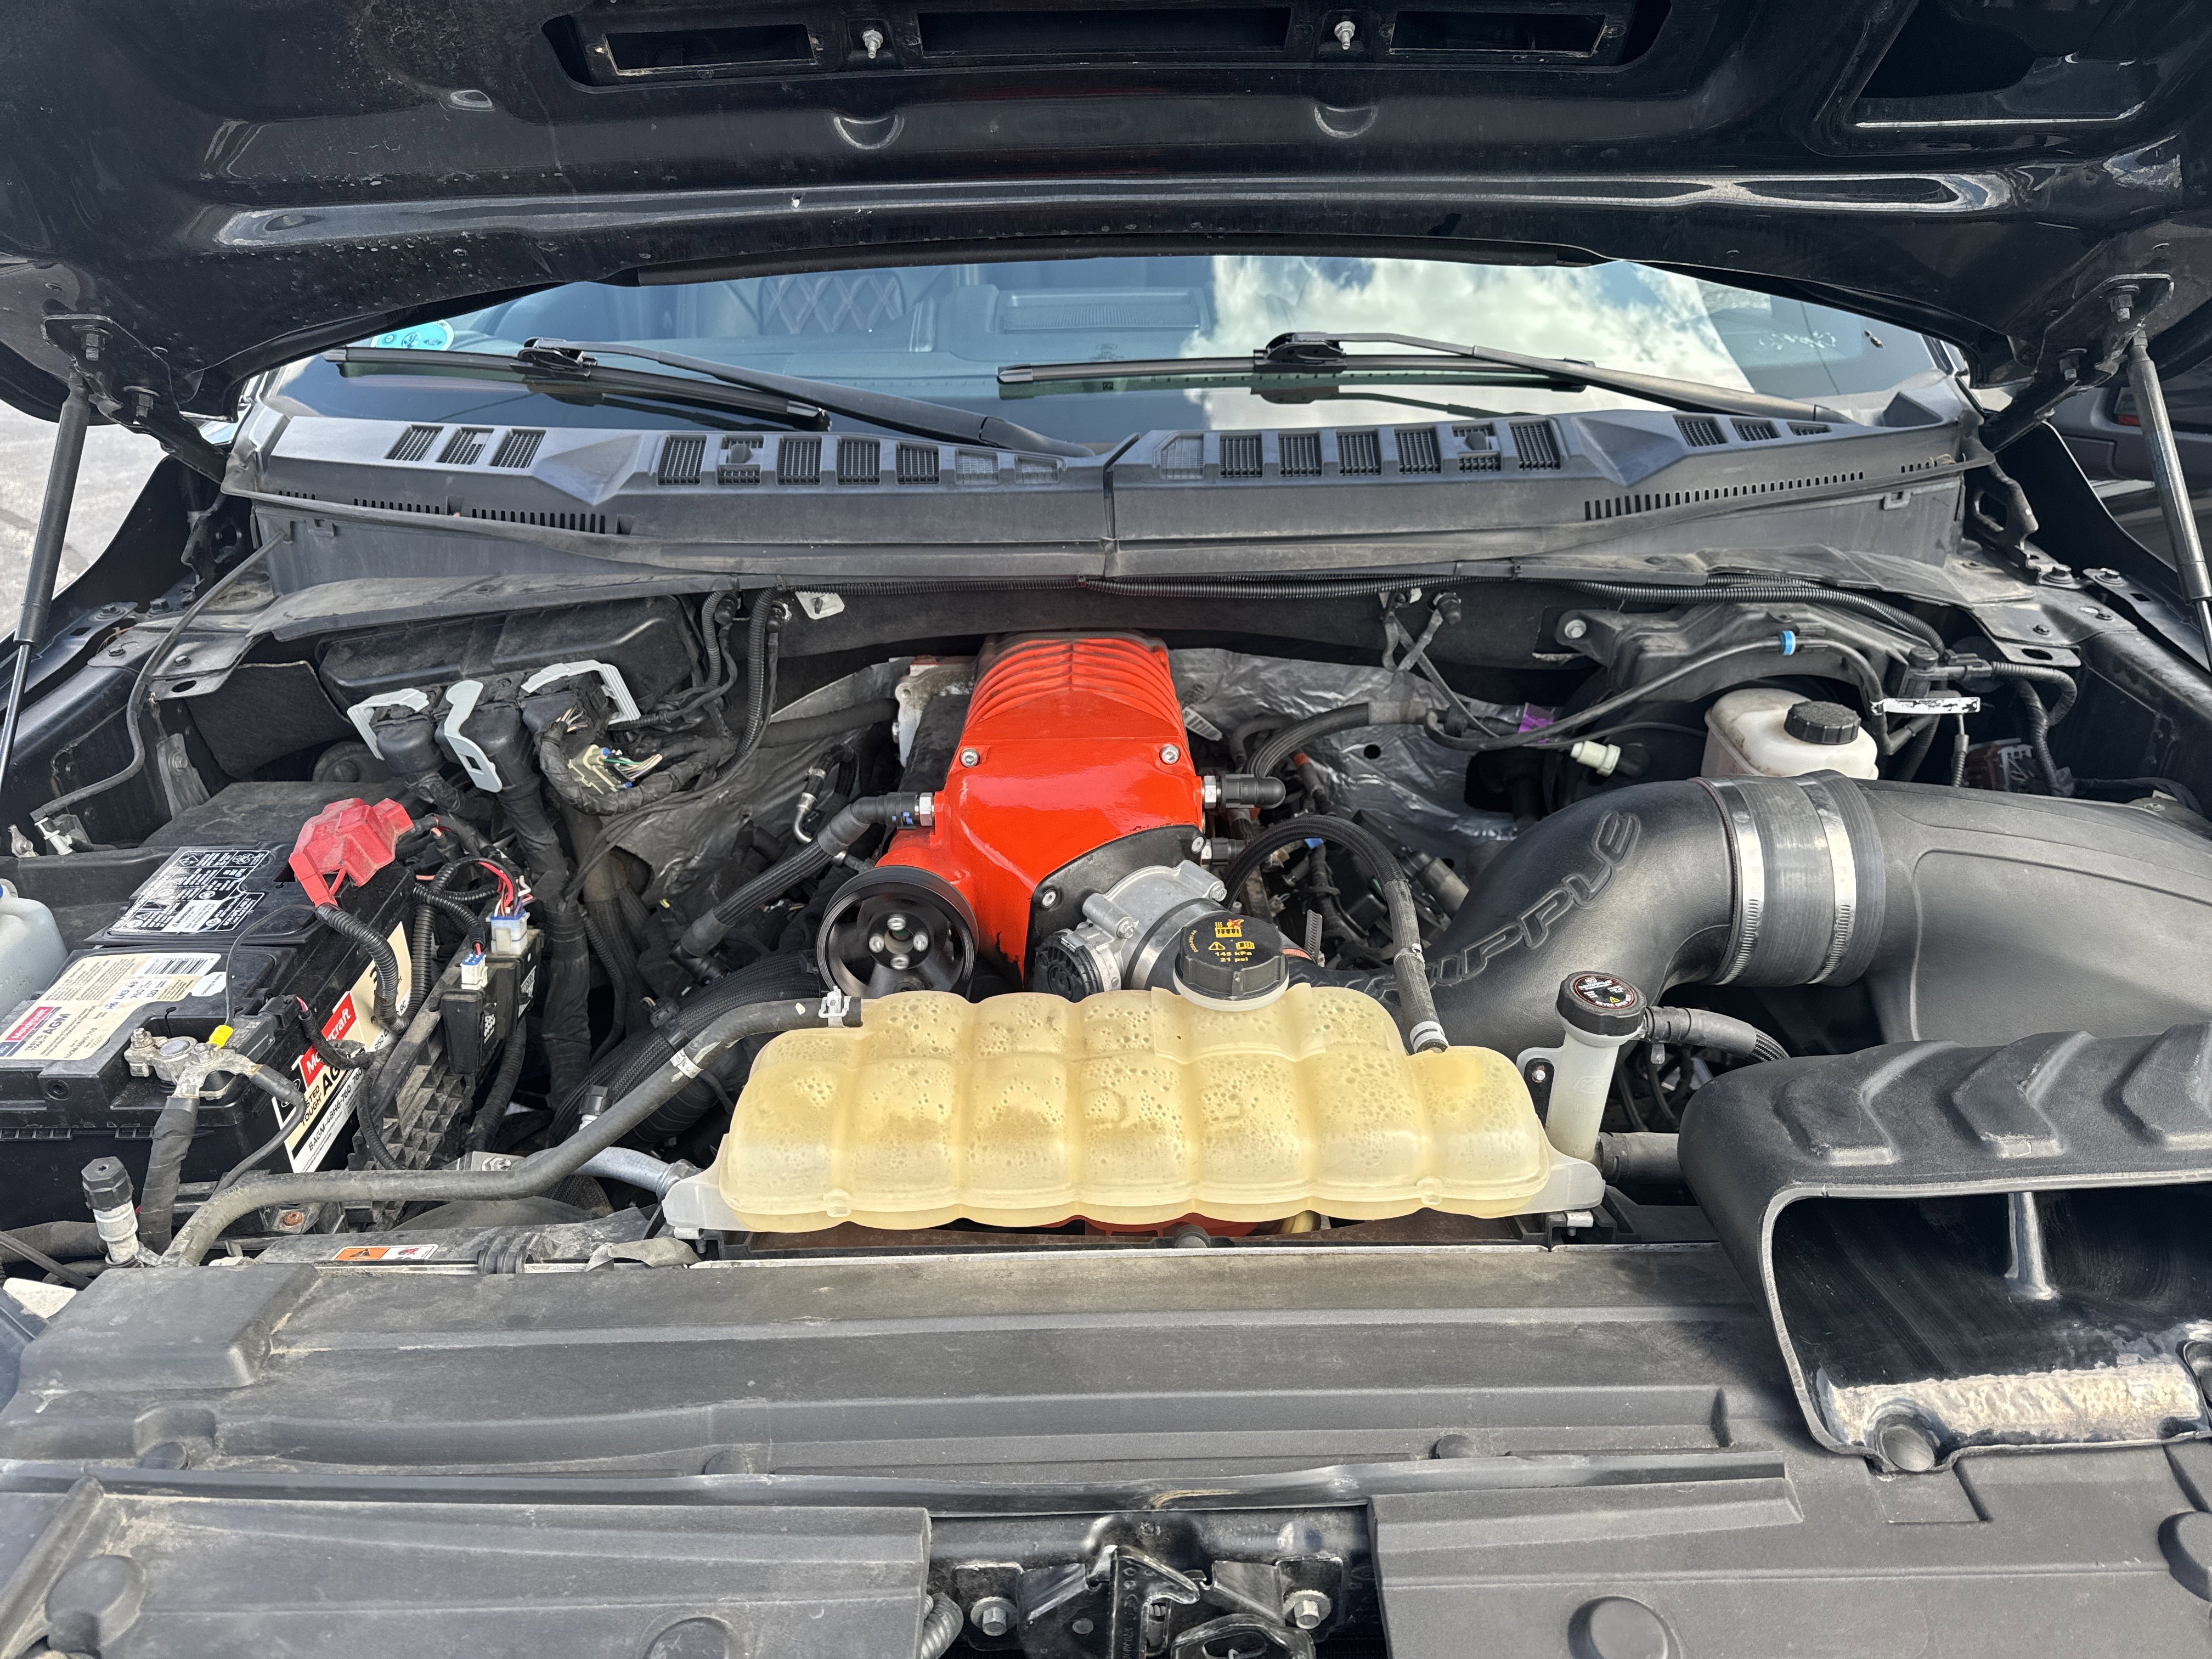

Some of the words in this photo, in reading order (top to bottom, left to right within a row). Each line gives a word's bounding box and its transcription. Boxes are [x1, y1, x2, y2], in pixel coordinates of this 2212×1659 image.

[1393, 811, 1641, 991] IPPLE
[130, 989, 144, 999] 760
[145, 989, 159, 998] 120
[400, 1000, 407, 1013] RC
[11, 1008, 49, 1039] Motorcraft
[42, 1013, 71, 1035] AGM
[306, 1007, 352, 1075] Morcraft
[374, 1036, 384, 1052] 950
[306, 1085, 320, 1108] STED
[308, 1084, 351, 1152] BAGM-48H6-760
[352, 1068, 363, 1085] 760
